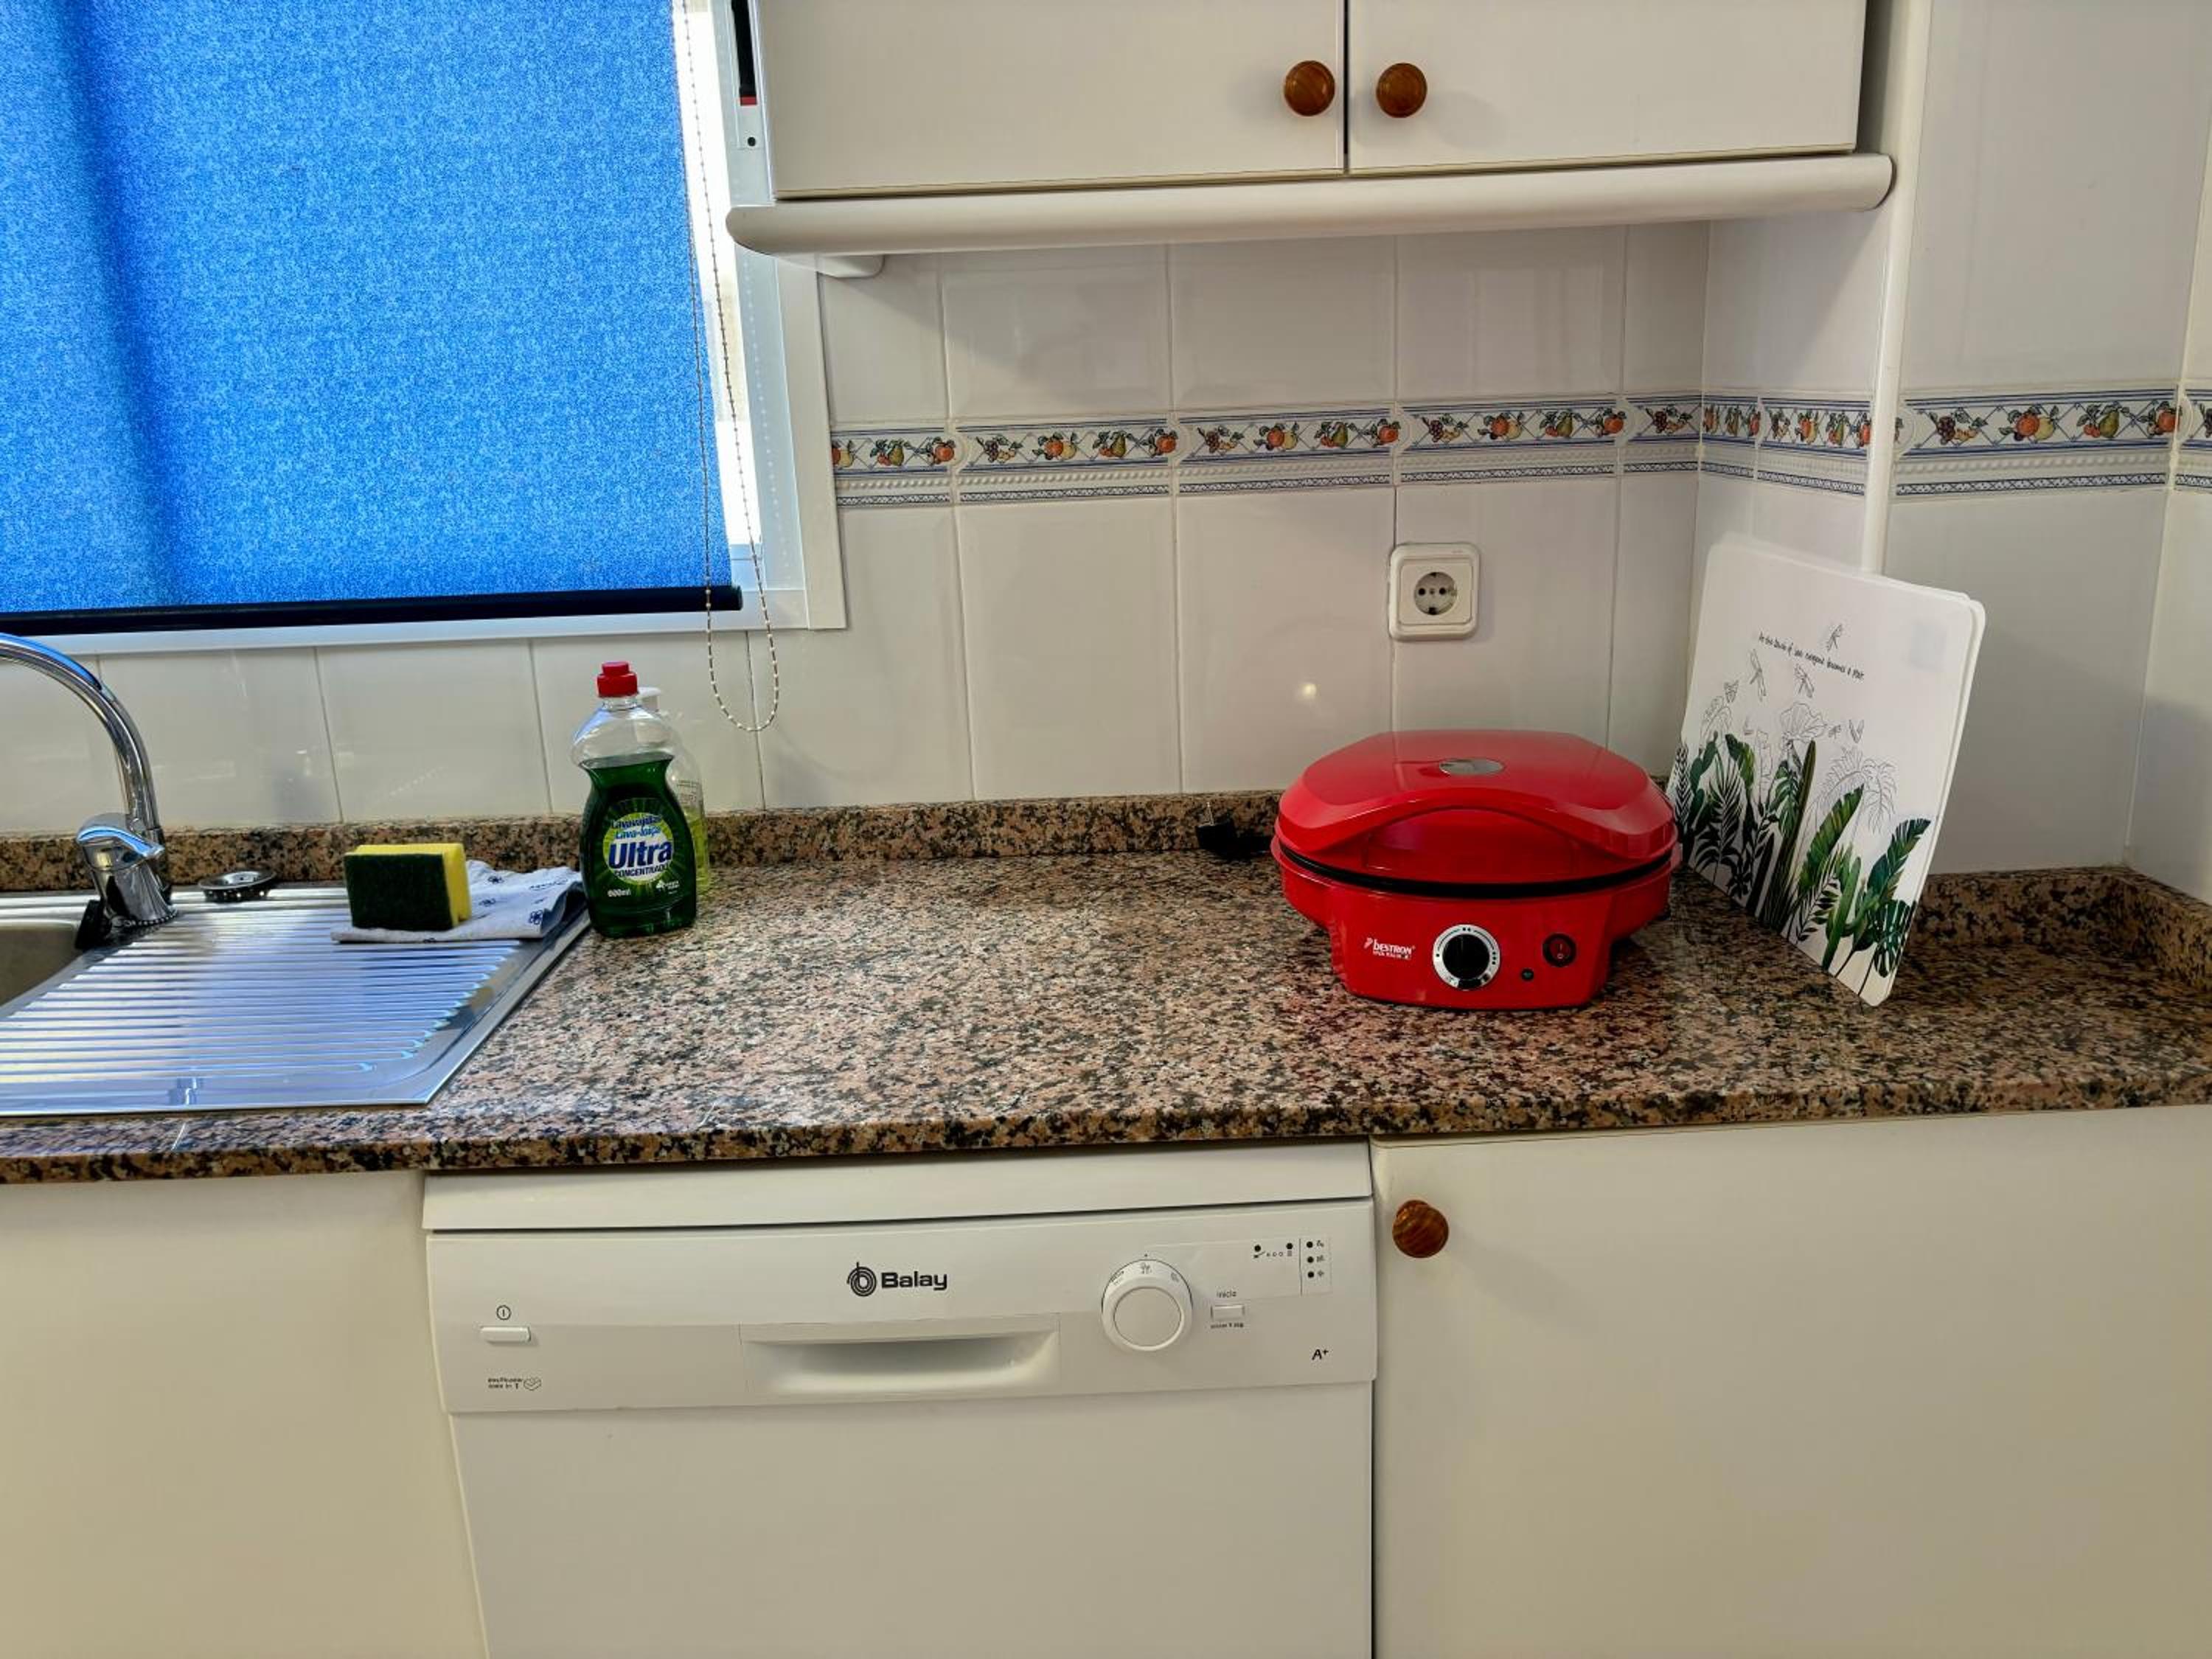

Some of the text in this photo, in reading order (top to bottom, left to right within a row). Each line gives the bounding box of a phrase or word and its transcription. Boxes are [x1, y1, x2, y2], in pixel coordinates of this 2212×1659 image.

[608, 841, 672, 869] Ultra
[881, 1270, 947, 1291] Balay
[1312, 1349, 1329, 1360] A+
